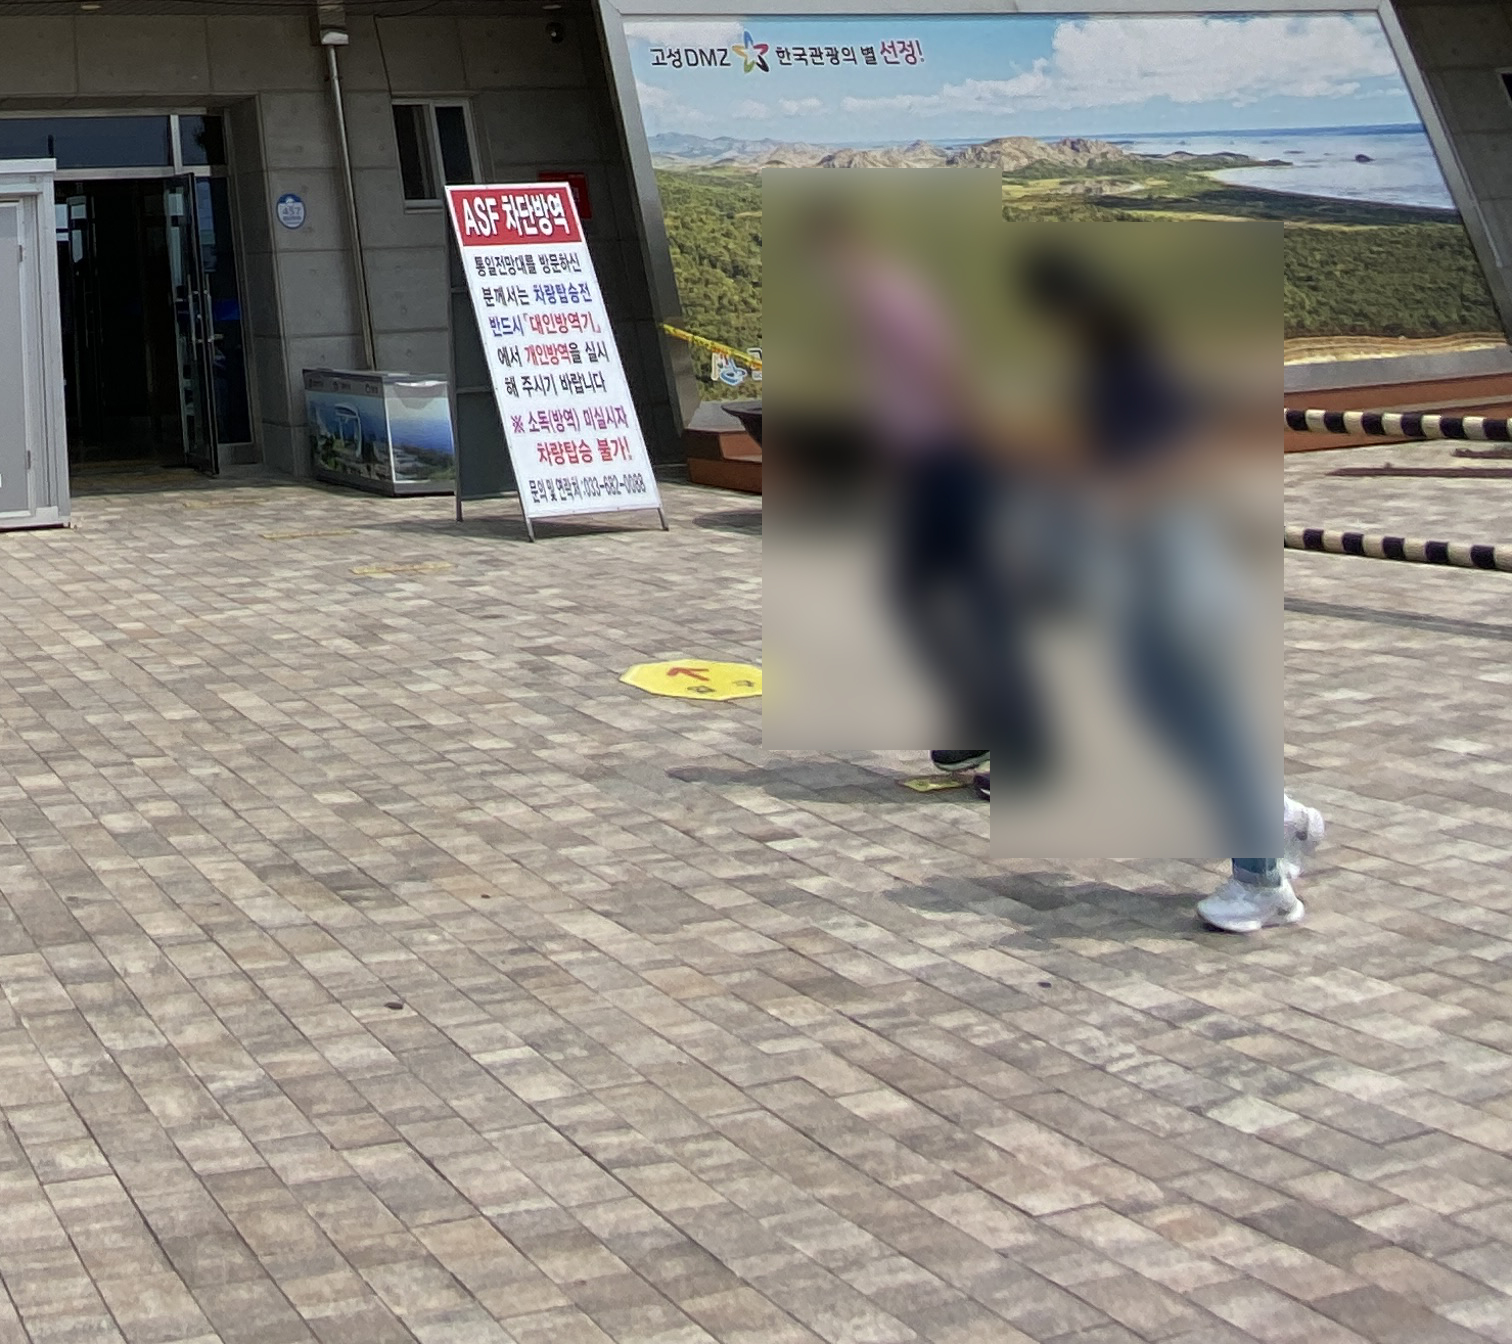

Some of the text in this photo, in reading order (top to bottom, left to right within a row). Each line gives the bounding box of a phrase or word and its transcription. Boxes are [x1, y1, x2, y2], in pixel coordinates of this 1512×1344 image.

[775, 46, 858, 67] 한국관광의
[860, 46, 878, 66] 별
[880, 39, 925, 66] 선정!
[462, 196, 500, 237] ASF
[500, 192, 571, 236] 차단방역
[474, 252, 582, 277] 통일전망대를 방문하신
[481, 281, 593, 307] 분께서는 차량탑승전
[488, 314, 525, 337] 반드시
[497, 340, 610, 367] 에서 개인방역을 실시
[504, 371, 608, 398] 해 주시기 바랍니다
[528, 407, 581, 433] 소독(방역)
[582, 405, 629, 431] 미실시자
[536, 435, 633, 466] 차량탑승 불가!
